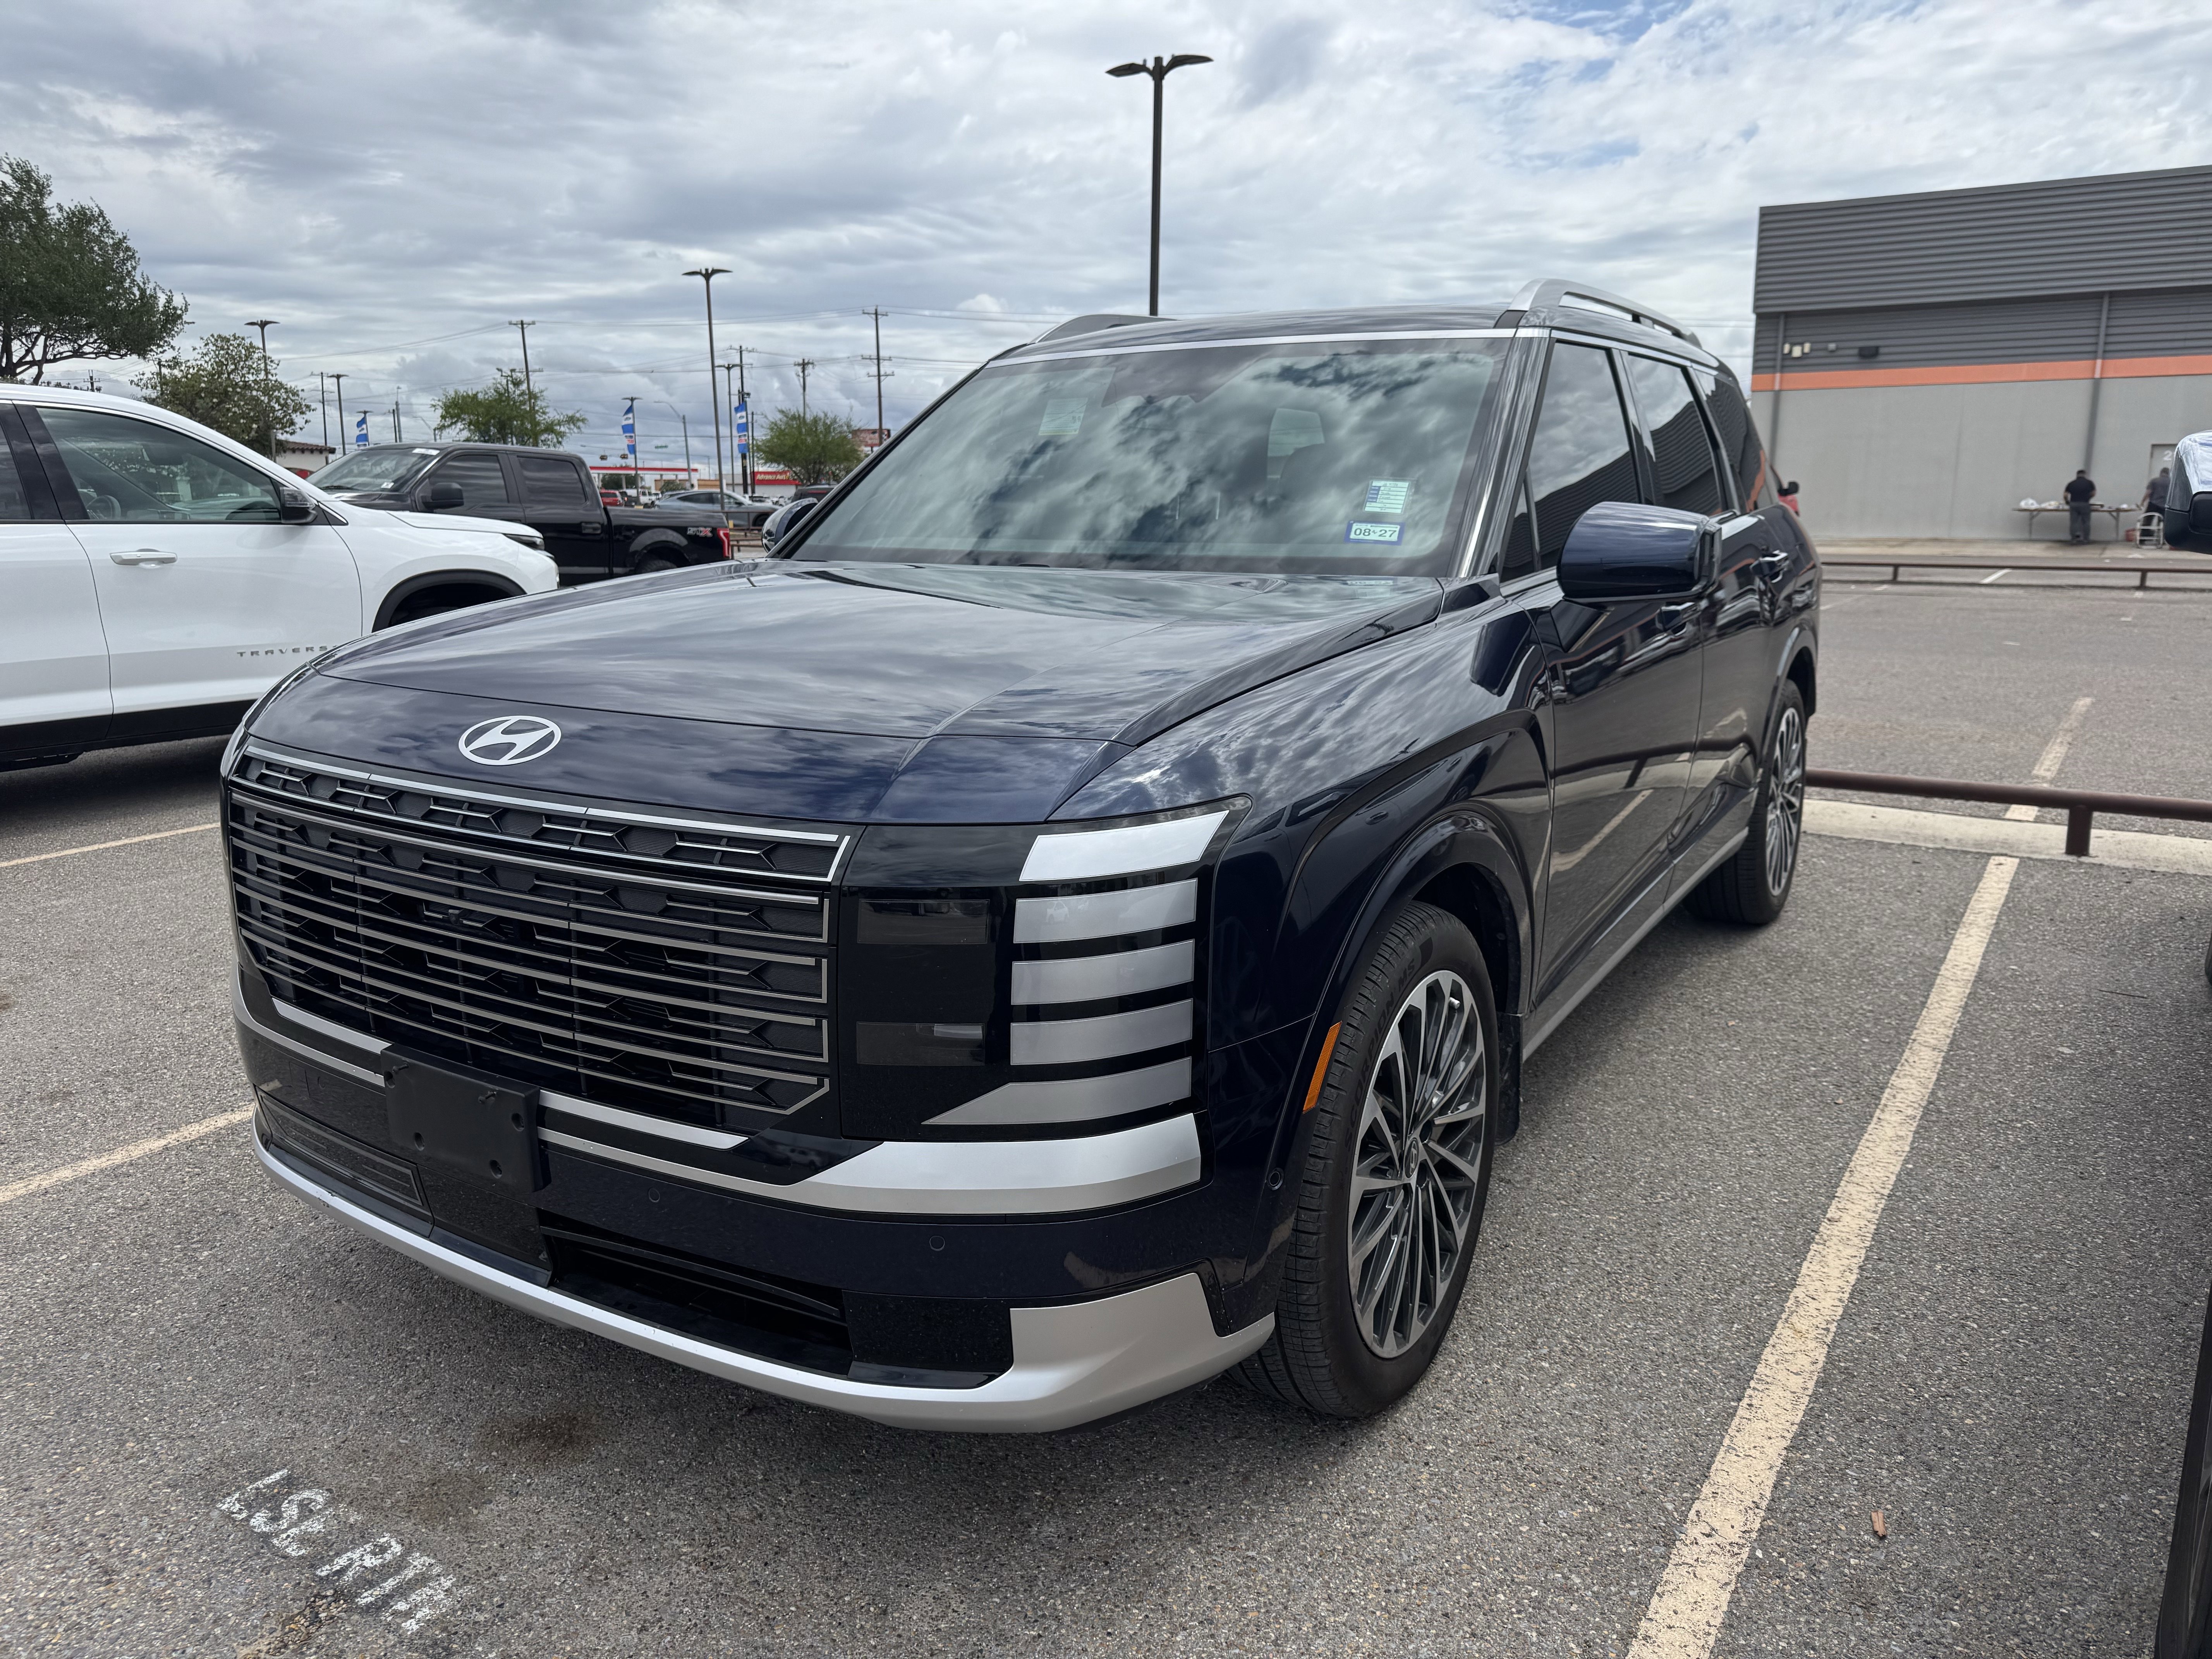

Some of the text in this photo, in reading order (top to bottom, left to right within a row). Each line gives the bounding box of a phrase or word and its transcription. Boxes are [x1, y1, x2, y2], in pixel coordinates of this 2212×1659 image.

[687, 527, 713, 537] STX
[237, 645, 338, 657] TRAVERS
[1345, 991, 1394, 1152] SCORPION
